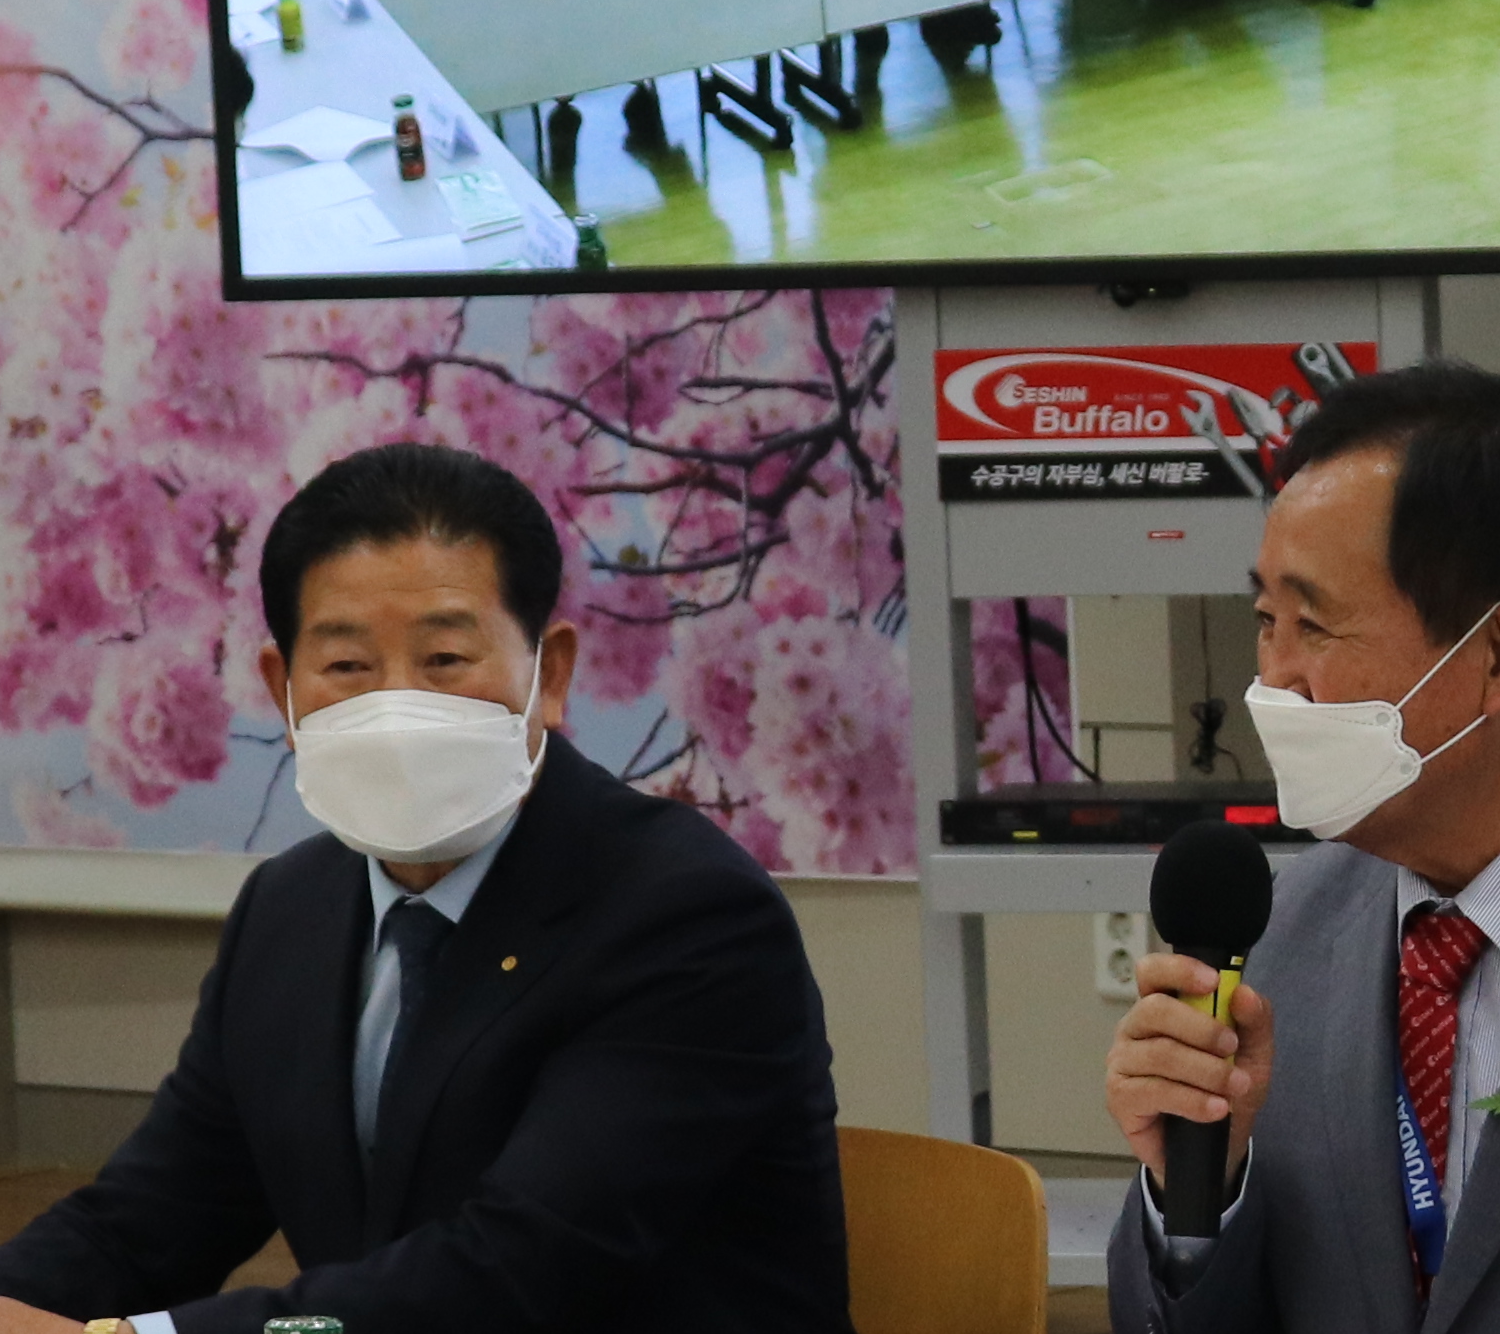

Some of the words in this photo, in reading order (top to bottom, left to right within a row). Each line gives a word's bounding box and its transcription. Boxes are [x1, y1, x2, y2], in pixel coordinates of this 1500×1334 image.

[1032, 404, 1170, 434] Buffalo
[970, 464, 1043, 487] 수공구의
[1109, 462, 1145, 485] 세신
